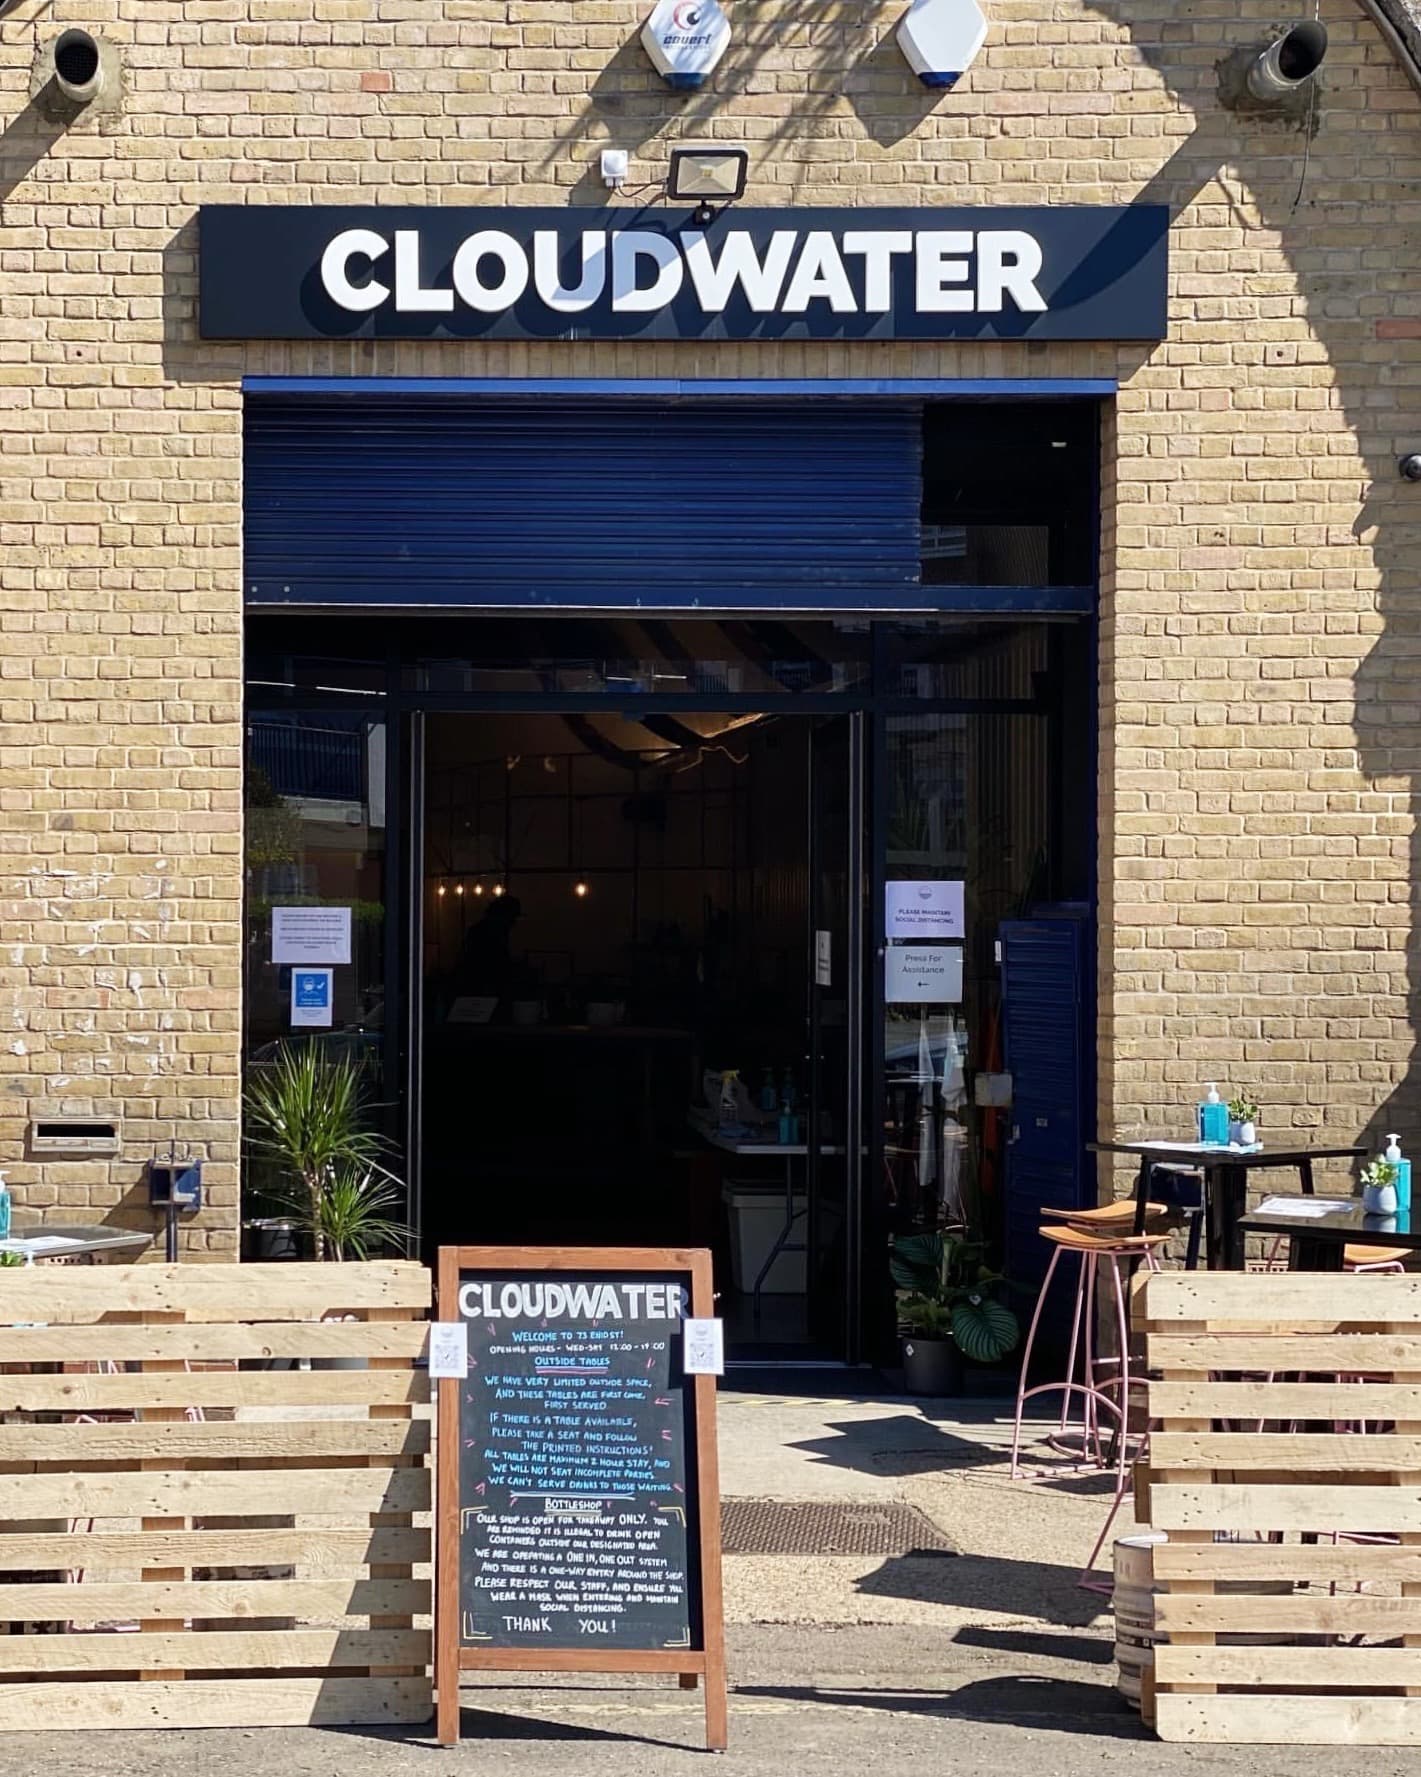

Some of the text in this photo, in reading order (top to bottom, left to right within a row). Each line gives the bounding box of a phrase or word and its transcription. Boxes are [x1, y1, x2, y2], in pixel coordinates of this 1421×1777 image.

[321, 229, 1049, 313] CLOUDWATER
[928, 954, 943, 962] For
[902, 966, 945, 974] Assistance
[458, 1283, 689, 1319] CLOUDWATER
[512, 1331, 557, 1341] WELCOME
[560, 1332, 573, 1340] TO
[489, 1345, 526, 1354] OPENING
[534, 1356, 611, 1366] OUTSIDE TABLES
[484, 1376, 500, 1386] WE
[503, 1376, 522, 1386] HAVE
[525, 1377, 549, 1386] VERY
[553, 1378, 586, 1386] LIMITED
[495, 1388, 515, 1399] AND
[517, 1390, 544, 1399] THESE
[546, 1390, 578, 1400] TABLES
[581, 1391, 598, 1399] ARE
[601, 1391, 622, 1399] FIRST
[544, 1400, 607, 1410] FIRST SERVED
[490, 1412, 499, 1423] IF
[502, 1413, 530, 1424] THERE
[533, 1415, 541, 1424] IS
[544, 1416, 551, 1424] A
[552, 1416, 581, 1425] TABLE
[492, 1427, 637, 1441] PLEASE TAKE A SEAT AND FOLLOW
[521, 1441, 539, 1451] THE
[542, 1442, 582, 1453] PRINTED
[484, 1449, 499, 1459] ALL
[502, 1452, 529, 1461] TABLES
[531, 1454, 547, 1462] ARE
[549, 1455, 589, 1465] MAXIMUM
[600, 1458, 624, 1467] HOUR
[627, 1459, 652, 1470] STAY,
[654, 1460, 670, 1468] AND
[491, 1463, 507, 1473] WE
[509, 1464, 529, 1473] WILL
[531, 1466, 548, 1475] NOT
[551, 1467, 572, 1476] SEAT
[575, 1468, 622, 1478] INCOMPLETE
[488, 1476, 505, 1485] WE
[507, 1476, 532, 1486] CAN'T
[537, 1480, 566, 1488] SERVE
[569, 1481, 597, 1489] DRINKS
[599, 1481, 609, 1489] TO
[612, 1482, 636, 1491] THOSE
[545, 1498, 602, 1510] BOTTLESHOP
[476, 1514, 497, 1524] OUR
[500, 1515, 520, 1524] SHOP
[522, 1516, 530, 1524] IS
[532, 1516, 554, 1525] OPEN
[619, 1513, 648, 1525] ONLY.
[486, 1525, 500, 1533] ARE
[502, 1525, 541, 1535] REMINDED
[544, 1527, 552, 1535] IT
[564, 1528, 593, 1536] ILLEGAL
[594, 1529, 604, 1537] TO
[607, 1530, 632, 1538] DRINK
[635, 1530, 660, 1540] OPEN
[489, 1534, 536, 1545] CONTAINERS
[590, 1541, 635, 1550] DESIGNATED
[474, 1548, 668, 1567] WE ARE OPERATING A ONE IN, ONE OUT SYSTEM
[481, 1561, 499, 1573] AND
[501, 1564, 526, 1573] THERE
[529, 1565, 538, 1573] IS
[540, 1566, 547, 1574] A
[548, 1566, 586, 1576] ONE-WAY
[586, 1568, 615, 1577] ENTRY
[617, 1569, 647, 1578] AROUND
[649, 1571, 663, 1580] THE
[474, 1576, 507, 1588] PLEASE
[510, 1578, 549, 1588] RESPECT
[554, 1580, 577, 1590] OUR
[612, 1582, 630, 1592] AND
[633, 1583, 665, 1592] ENSURE
[490, 1591, 517, 1601] WEAR
[519, 1591, 526, 1600] A
[528, 1592, 552, 1601] MASK
[555, 1593, 579, 1601] WHEN
[583, 1593, 623, 1602] ENTERING
[626, 1594, 642, 1602] AND
[539, 1603, 569, 1612] SOCIAL
[502, 1616, 552, 1632] THANK
